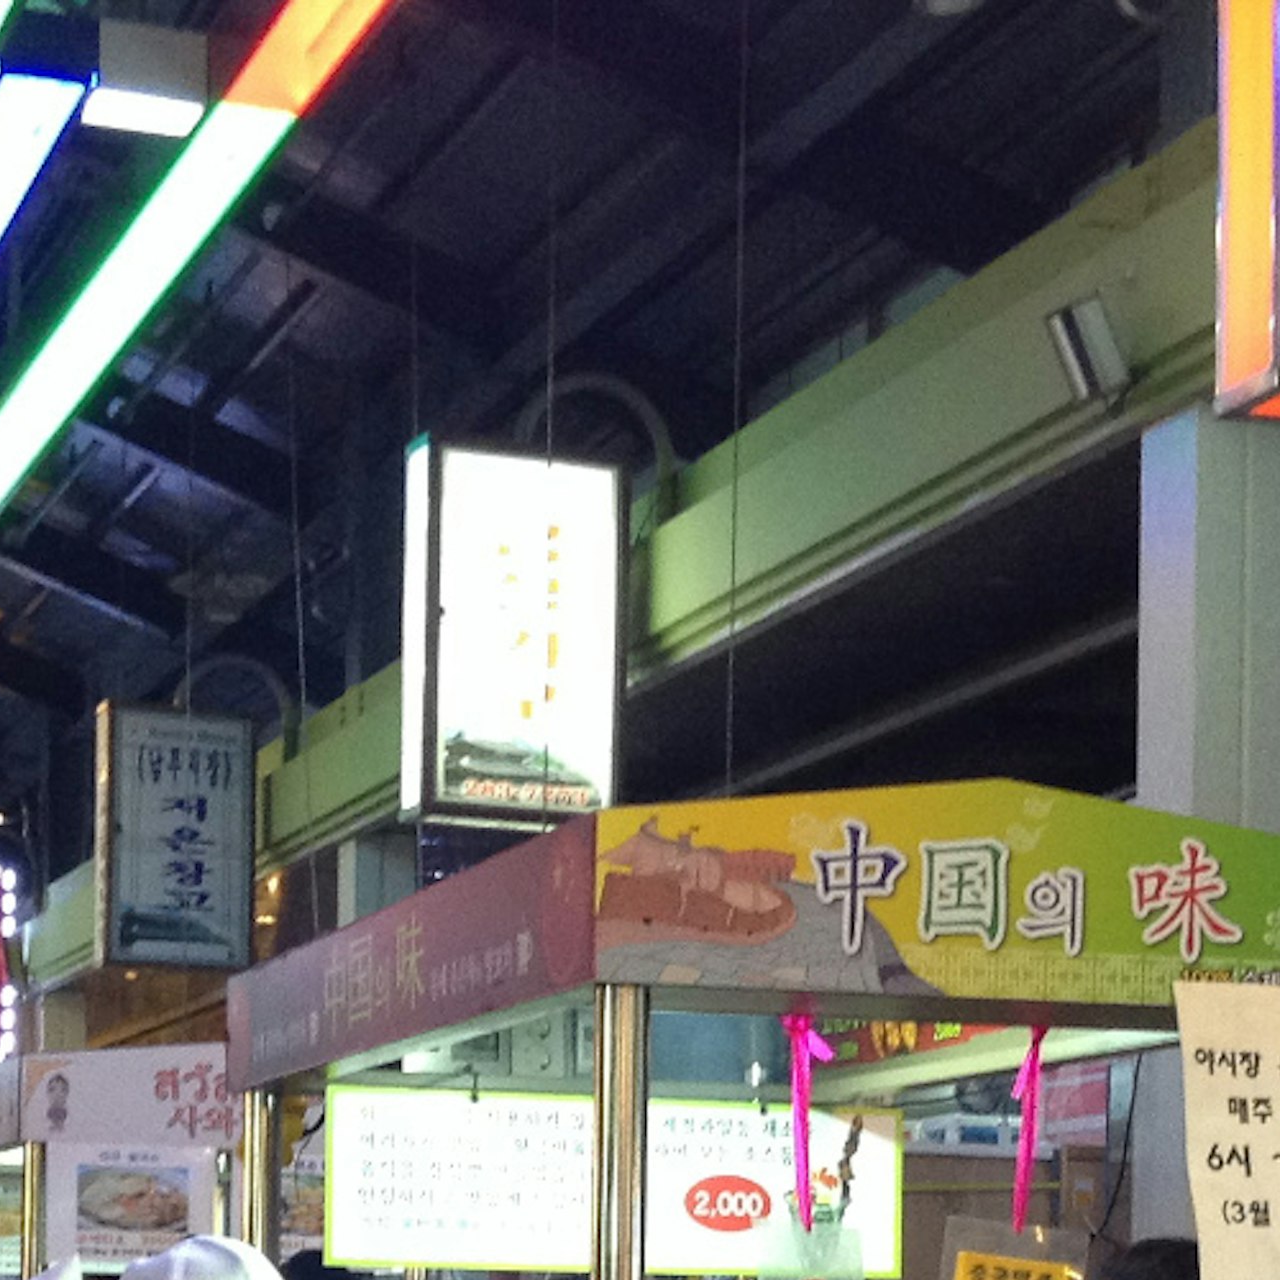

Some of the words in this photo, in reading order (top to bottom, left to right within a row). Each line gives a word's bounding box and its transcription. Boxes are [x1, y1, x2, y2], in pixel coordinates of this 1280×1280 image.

[813, 820, 1086, 957] 中国의
[1129, 837, 1243, 964] 味
[1194, 1048, 1261, 1079] 야시장
[1227, 1097, 1273, 1124] 매주
[1206, 1144, 1252, 1177] 6시
[693, 1190, 764, 1218] 2,000
[1221, 1199, 1271, 1227] (3월
